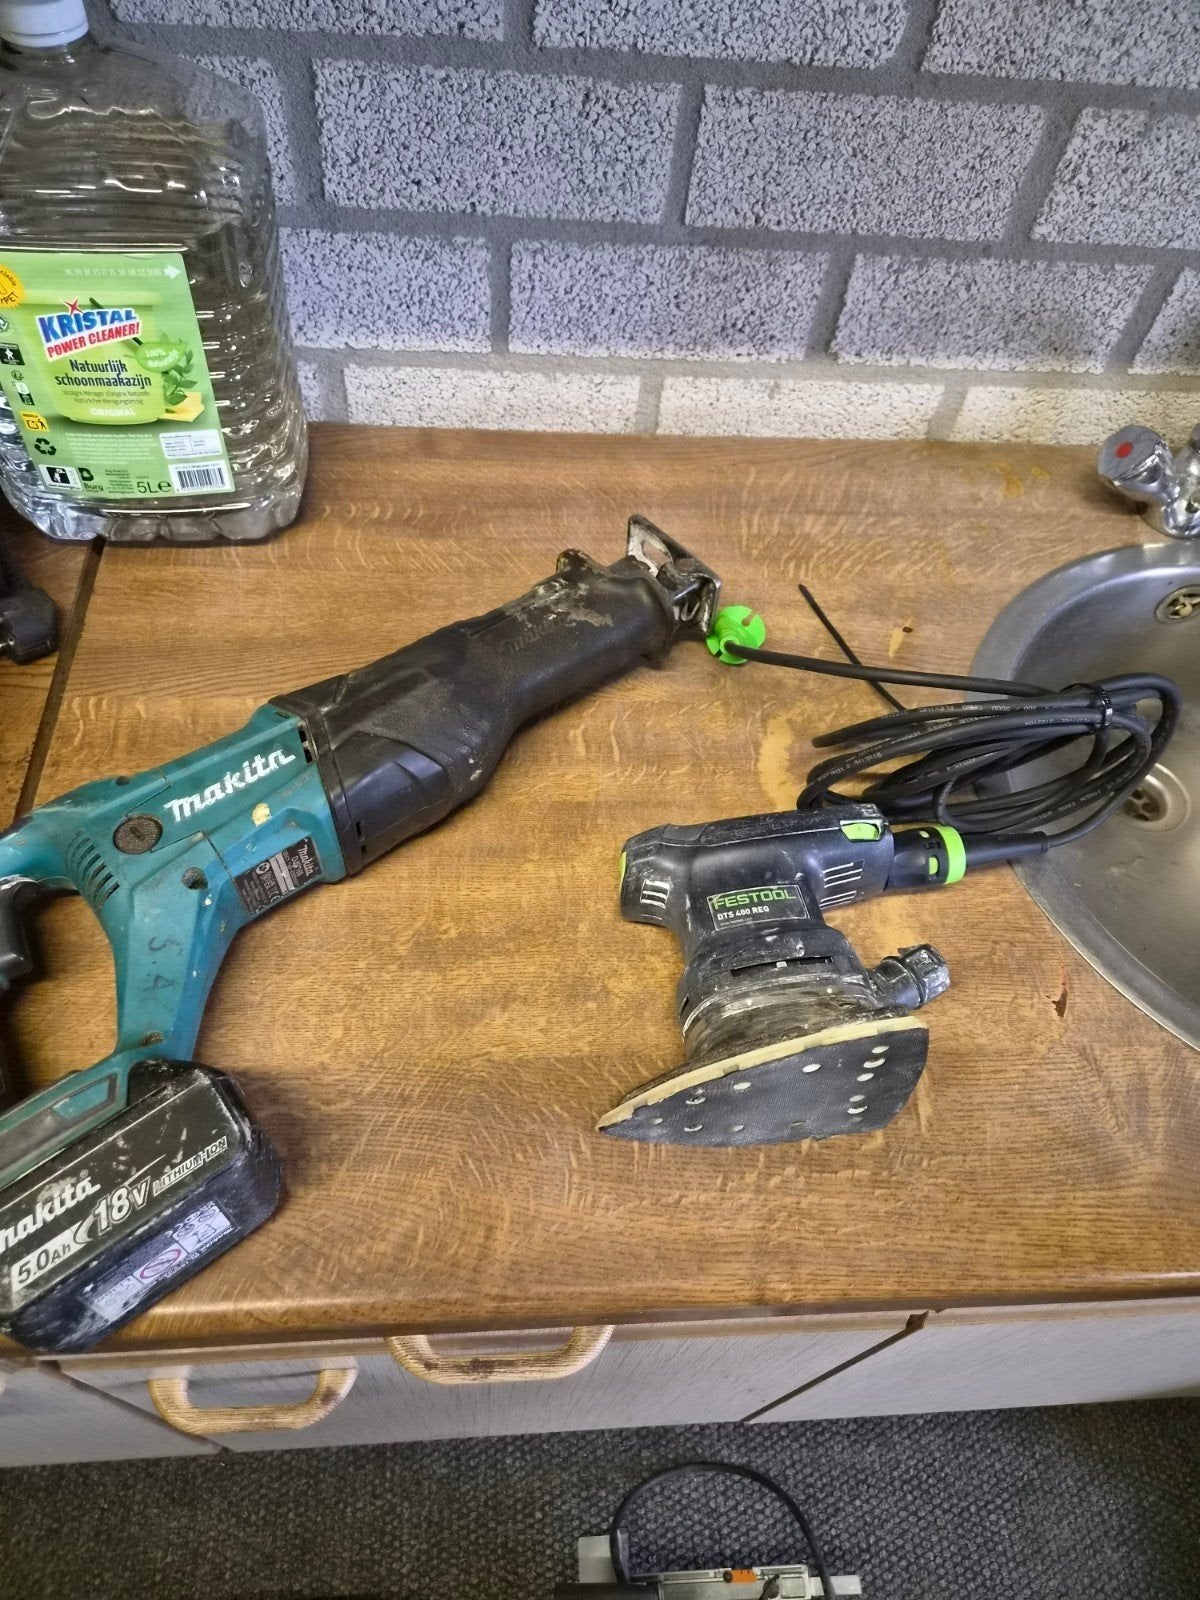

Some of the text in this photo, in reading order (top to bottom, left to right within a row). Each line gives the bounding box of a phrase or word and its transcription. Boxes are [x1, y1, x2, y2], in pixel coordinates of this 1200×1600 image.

[38, 309, 138, 343] KRISTAL
[46, 322, 140, 359] POWER CLEANER!
[69, 359, 128, 376] Natuurlijk
[55, 373, 152, 389] schoonmaakazijn
[90, 407, 136, 416] ORIGINAL
[84, 483, 104, 492] Burg
[713, 889, 797, 910] FESTOOL
[717, 905, 770, 921] DTS 400 REQ
[17, 1243, 71, 1285] 5.0Ah
[153, 1136, 228, 1196] LITHIUM-ION
